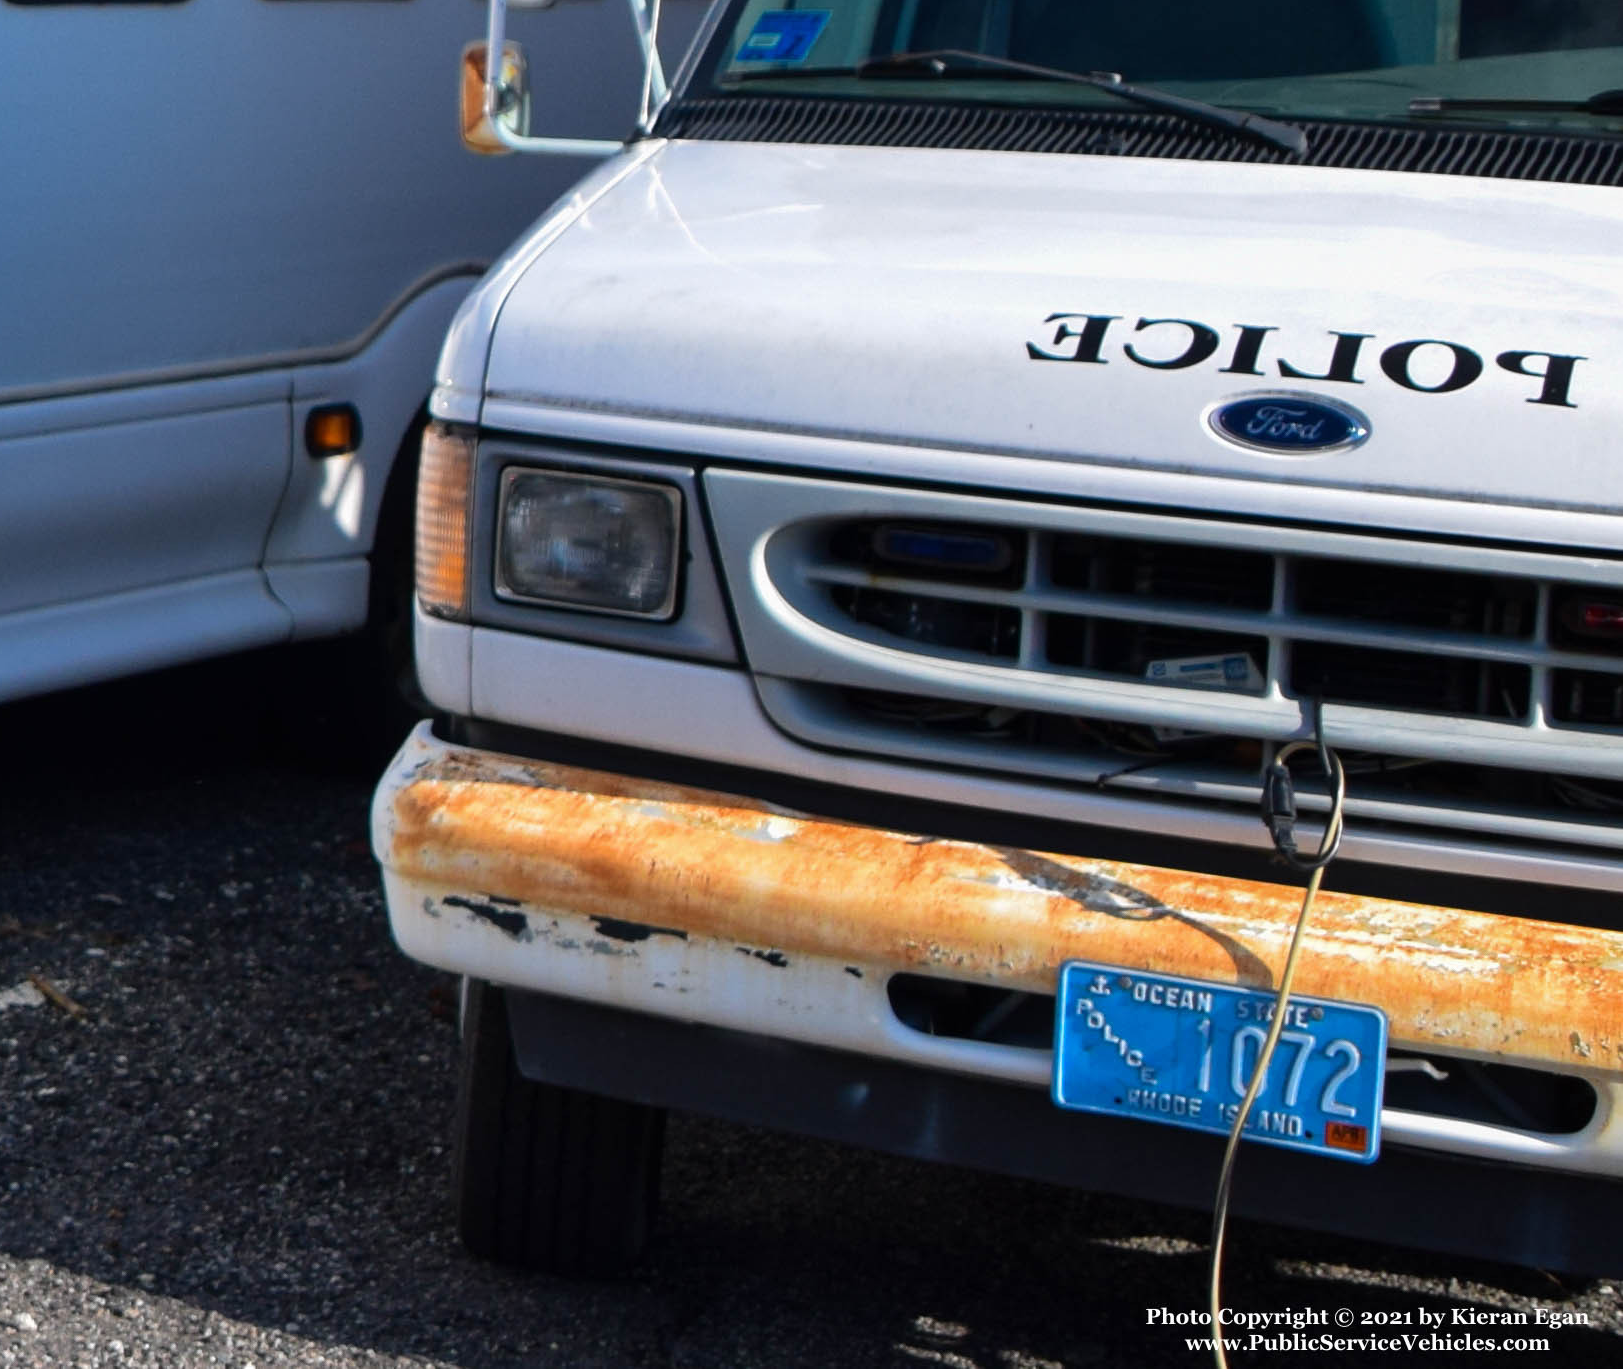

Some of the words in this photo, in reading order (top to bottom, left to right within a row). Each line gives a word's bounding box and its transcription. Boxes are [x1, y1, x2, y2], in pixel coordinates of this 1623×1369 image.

[1247, 405, 1325, 440] Ford
[1133, 981, 1213, 1013] OCEAN
[1076, 997, 1158, 1085] POLICE
[1196, 1017, 1362, 1118] 1072
[1127, 1087, 1203, 1118] RHODE
